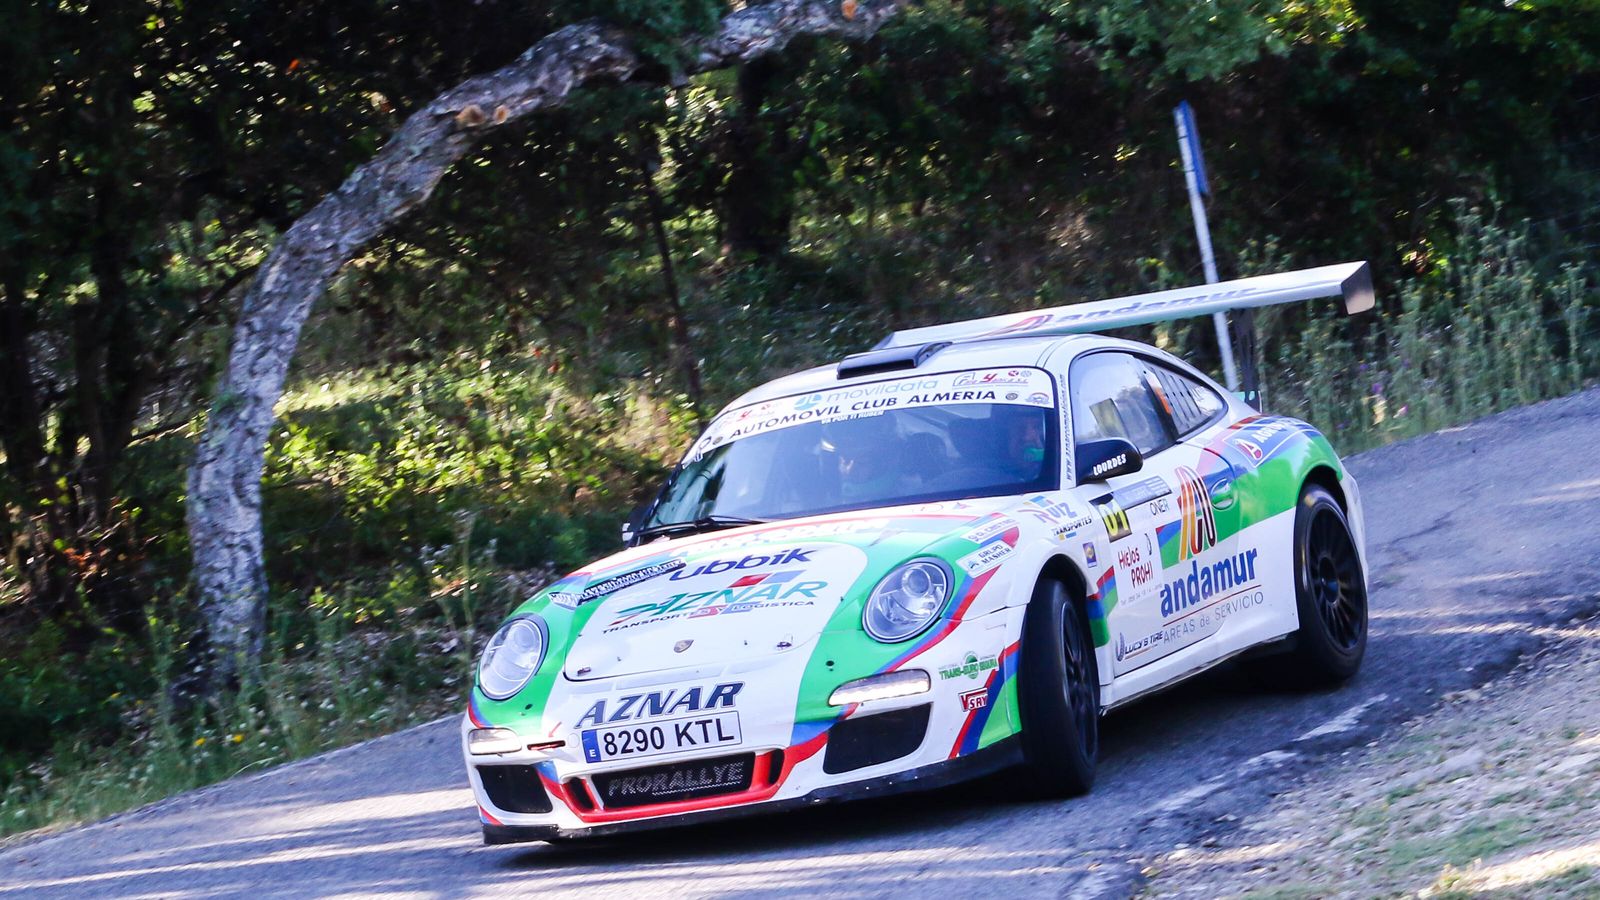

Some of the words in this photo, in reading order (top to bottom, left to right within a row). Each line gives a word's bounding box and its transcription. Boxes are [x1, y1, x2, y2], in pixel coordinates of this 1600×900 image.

[826, 379, 939, 402] movildata
[730, 405, 841, 439] AUTOMOVIL
[851, 397, 897, 411] CLUB
[907, 391, 996, 404] ALMERIA
[1093, 453, 1127, 476] LOURDES
[1160, 548, 1258, 618] andamur
[603, 607, 710, 634] TRANSPORTES
[731, 600, 815, 612] LOGISTICA
[1163, 619, 1196, 644] AREAS
[1200, 615, 1210, 627] de
[1215, 591, 1264, 620] SERVICIO
[574, 682, 745, 729] AZNAR
[589, 749, 597, 757] E
[603, 726, 665, 756] 8290
[675, 718, 735, 747] KTL
[608, 762, 744, 796] PRORALLYE
